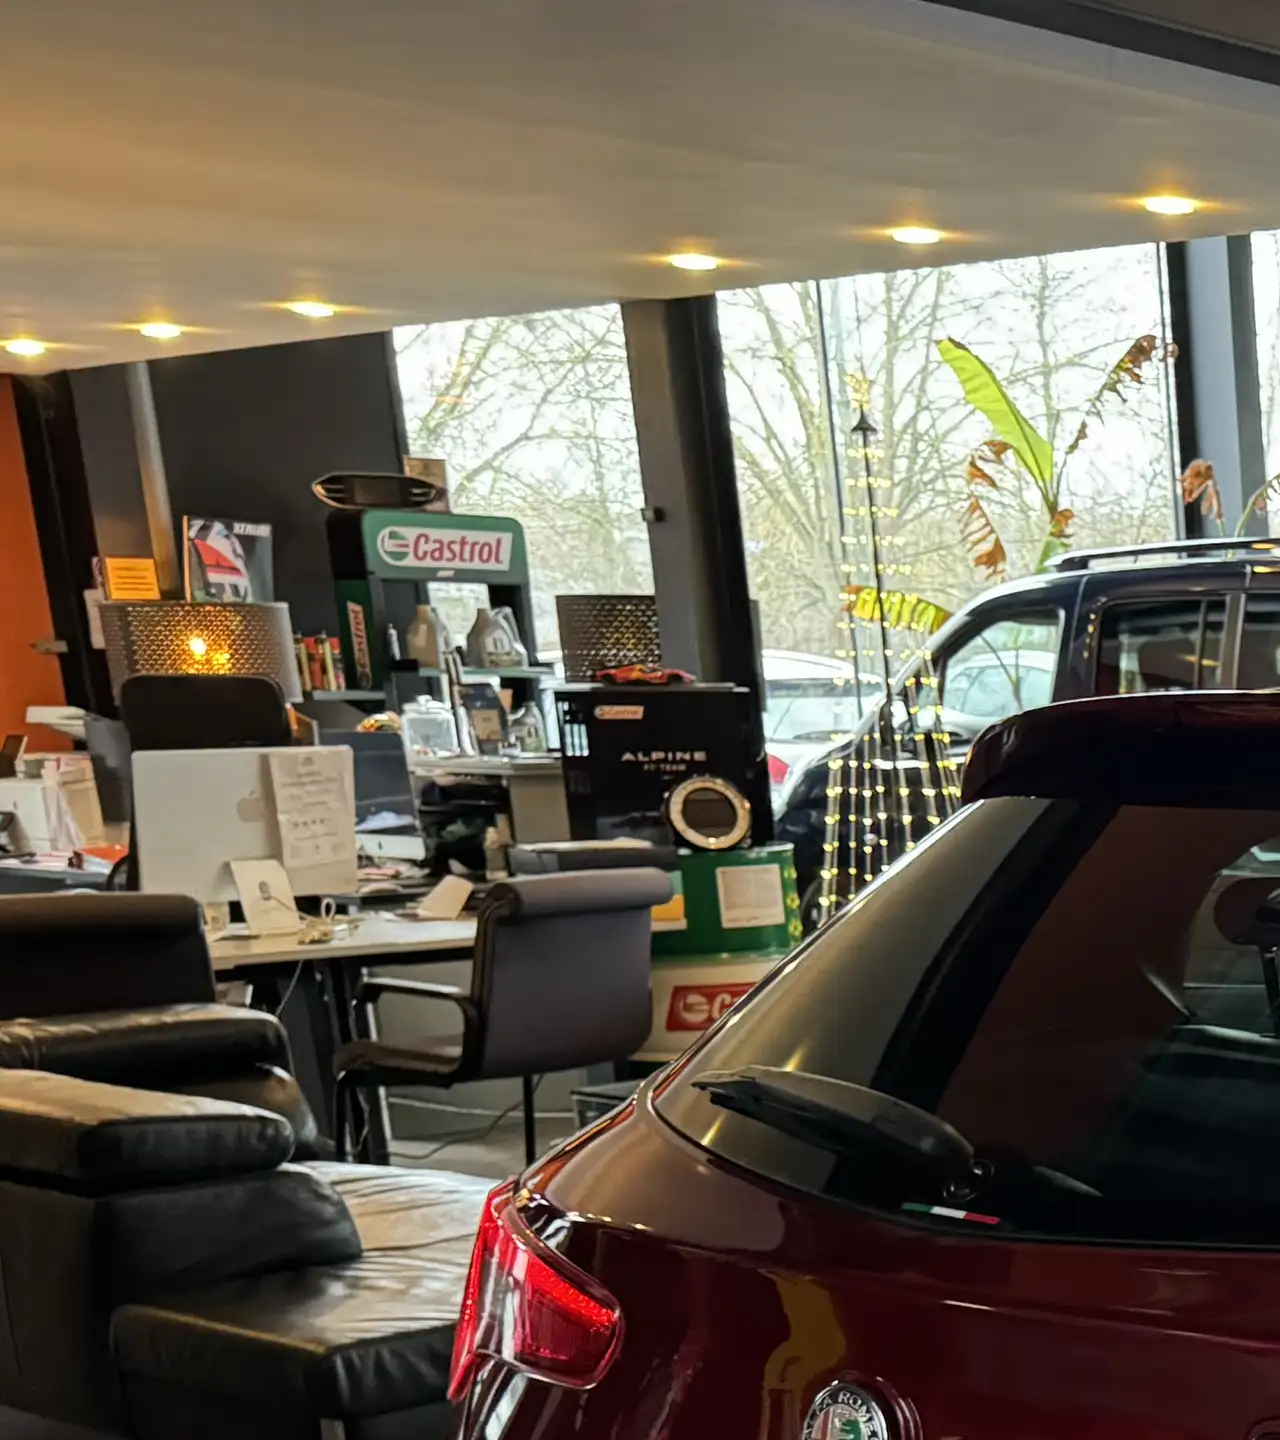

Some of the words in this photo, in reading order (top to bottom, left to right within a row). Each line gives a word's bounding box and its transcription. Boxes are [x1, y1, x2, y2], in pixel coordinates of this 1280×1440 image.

[412, 533, 503, 564] Castrol
[620, 750, 707, 762] ALPINE
[804, 1396, 833, 1440] ALFA
